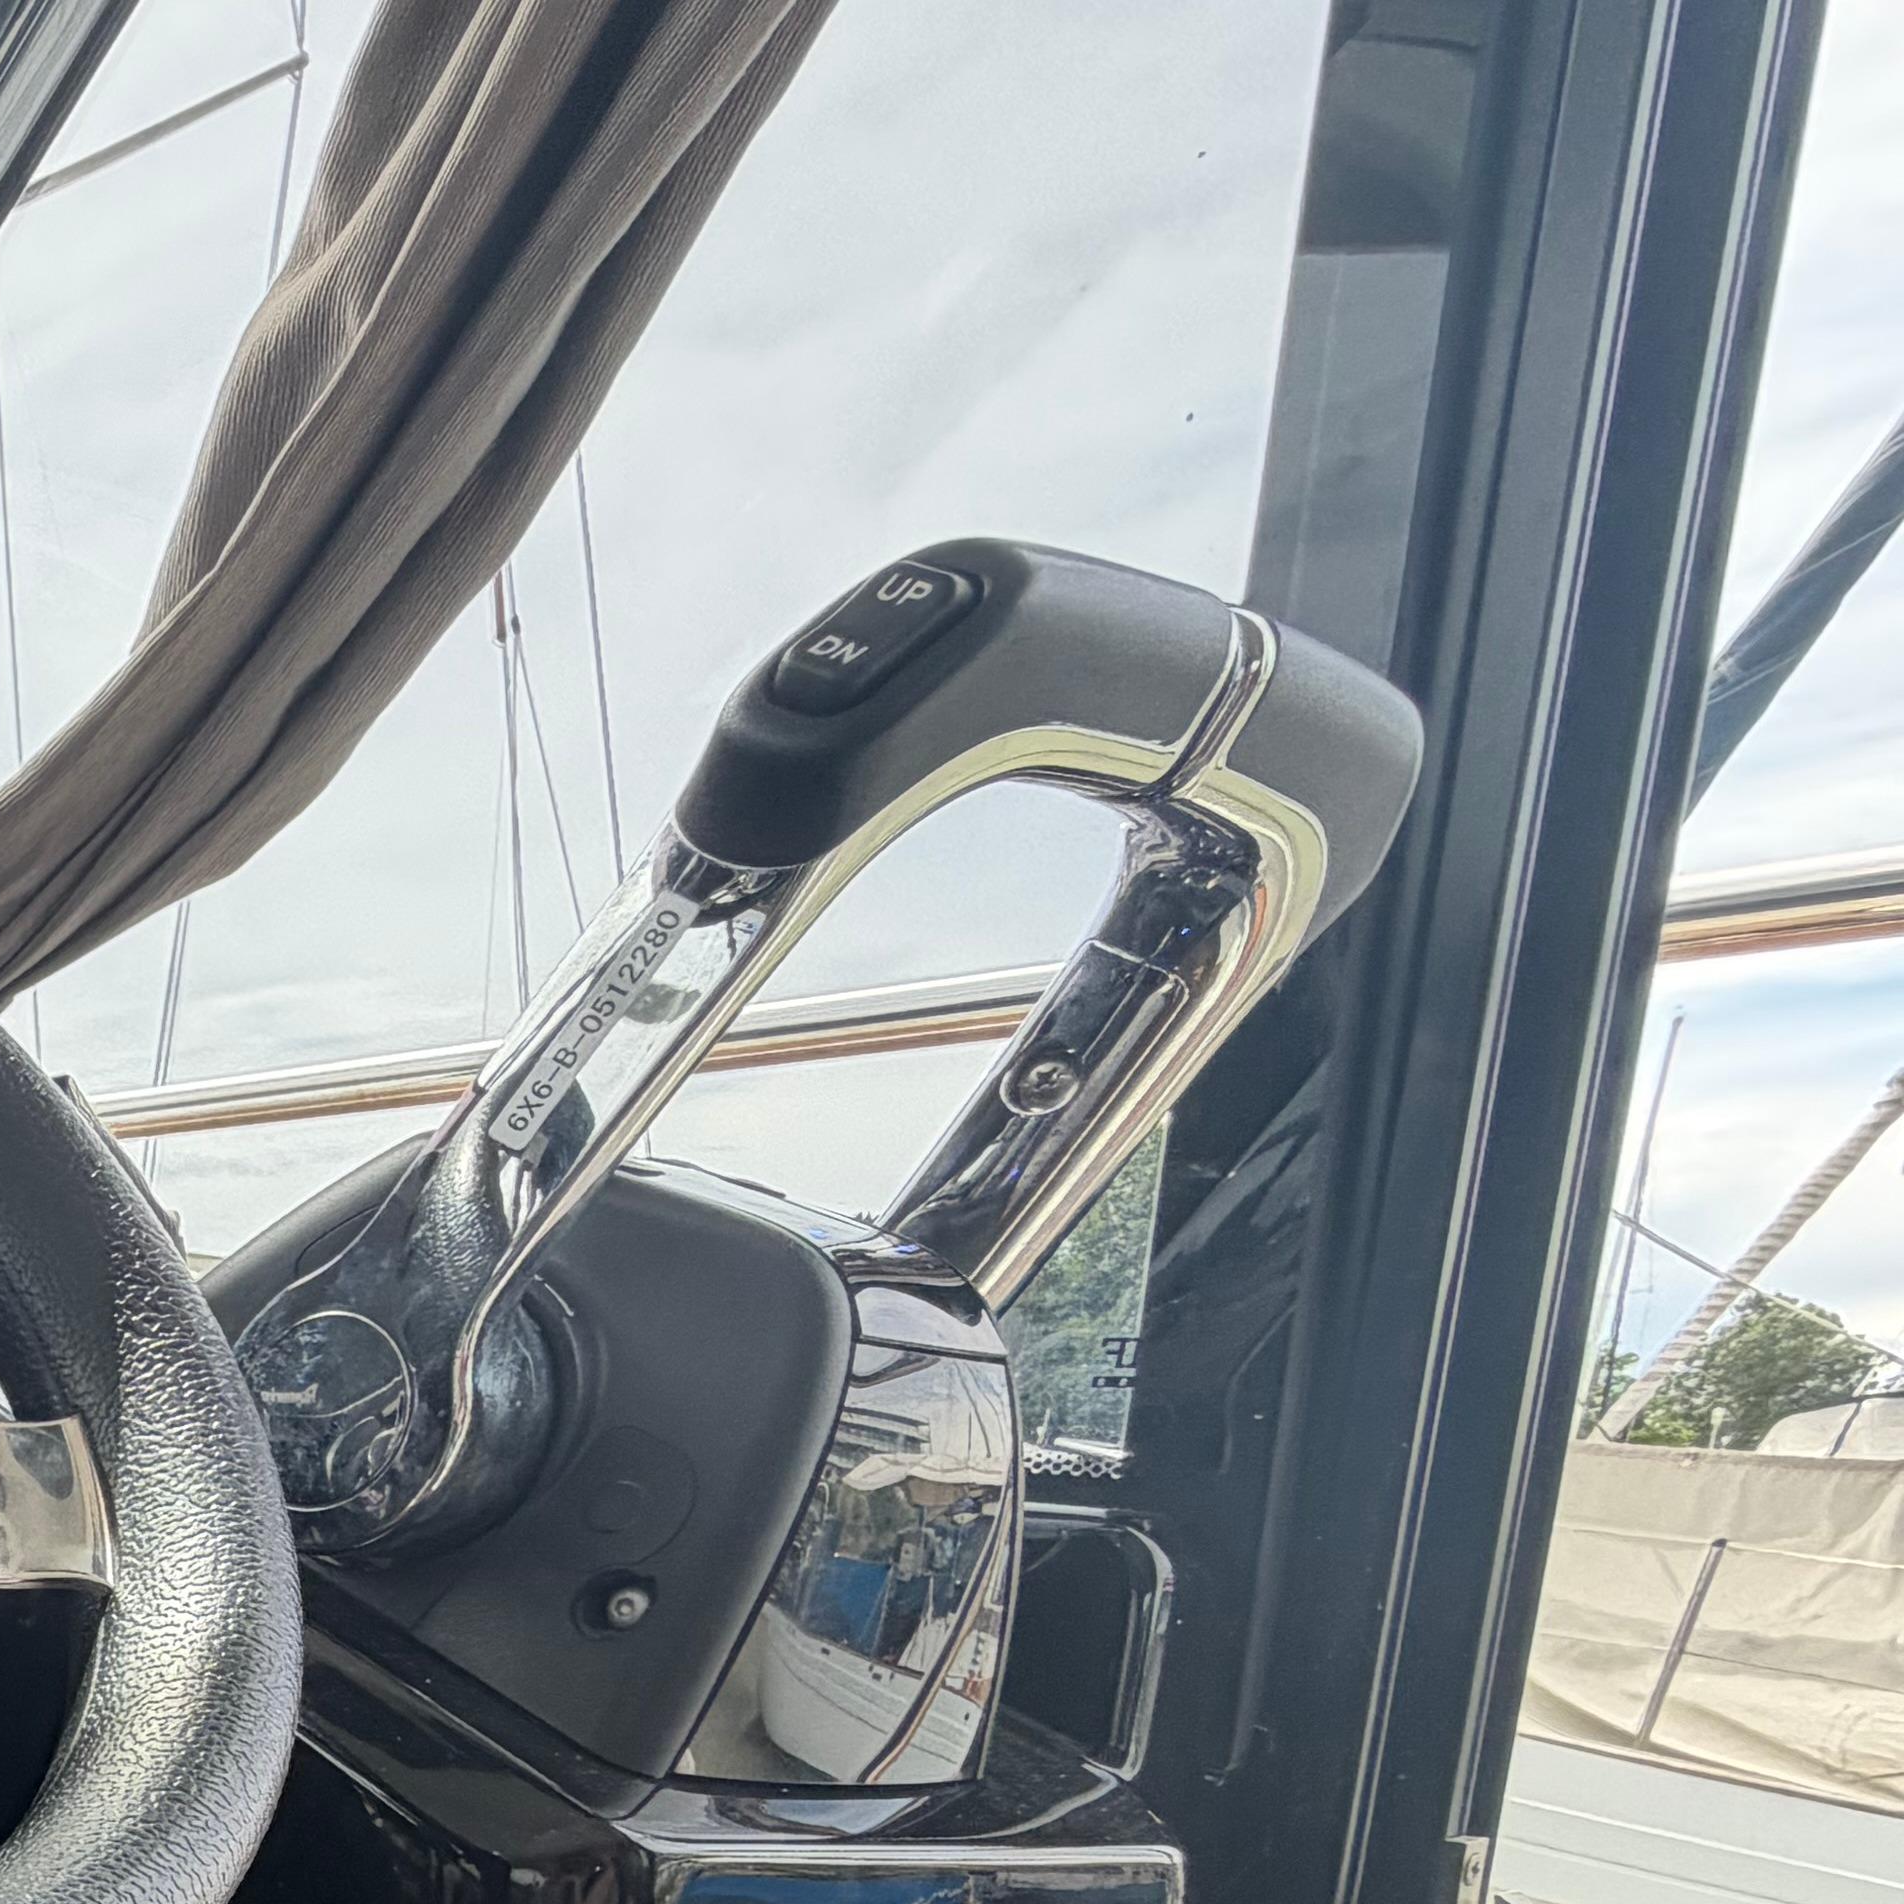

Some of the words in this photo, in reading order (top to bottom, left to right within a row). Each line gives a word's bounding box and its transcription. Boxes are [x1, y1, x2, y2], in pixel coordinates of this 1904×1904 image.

[876, 572, 934, 606] UP
[807, 634, 870, 665] DN
[507, 909, 681, 1132] 6X6-B-0512280
